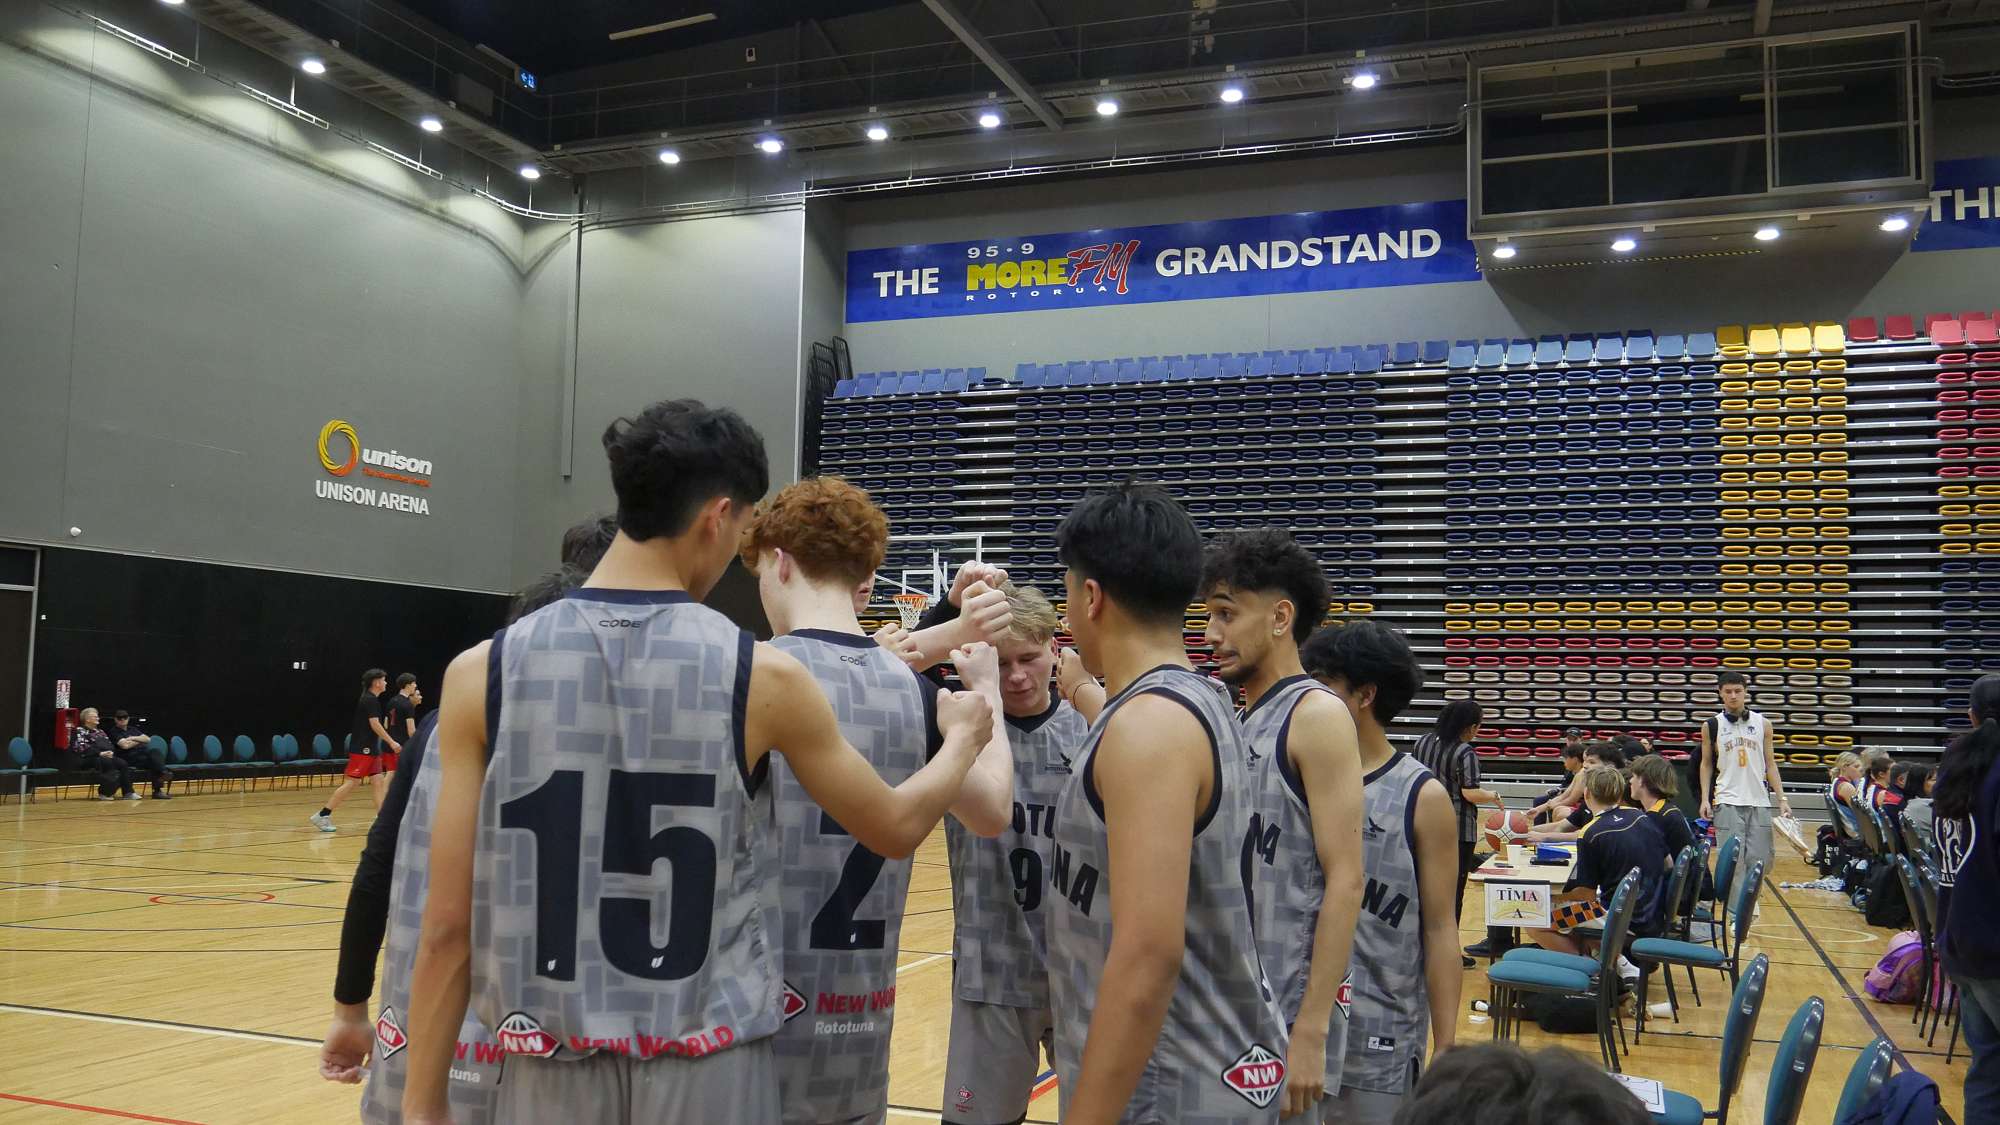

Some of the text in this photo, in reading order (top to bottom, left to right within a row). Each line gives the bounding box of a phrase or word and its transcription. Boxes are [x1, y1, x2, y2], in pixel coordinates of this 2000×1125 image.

[1929, 186, 2000, 222] TH
[873, 228, 1442, 297] THE MORE FM GRANDSTAND
[966, 285, 1107, 302] ROTORUA
[362, 448, 433, 475] unison
[315, 480, 430, 515] UNISON ARENA
[598, 619, 643, 628] CODE
[500, 769, 717, 982] 15
[1009, 847, 1043, 912] 9
[1051, 842, 1100, 918] NA
[1361, 877, 1410, 930] NA
[1512, 908, 1523, 918] A
[815, 991, 867, 1015] NEW
[379, 1023, 397, 1044] NW
[815, 1021, 874, 1035] Rototuna
[503, 1035, 544, 1053] NW
[637, 1025, 735, 1058] WORLD
[449, 1065, 481, 1083] tuna
[1243, 1065, 1277, 1086] NW
